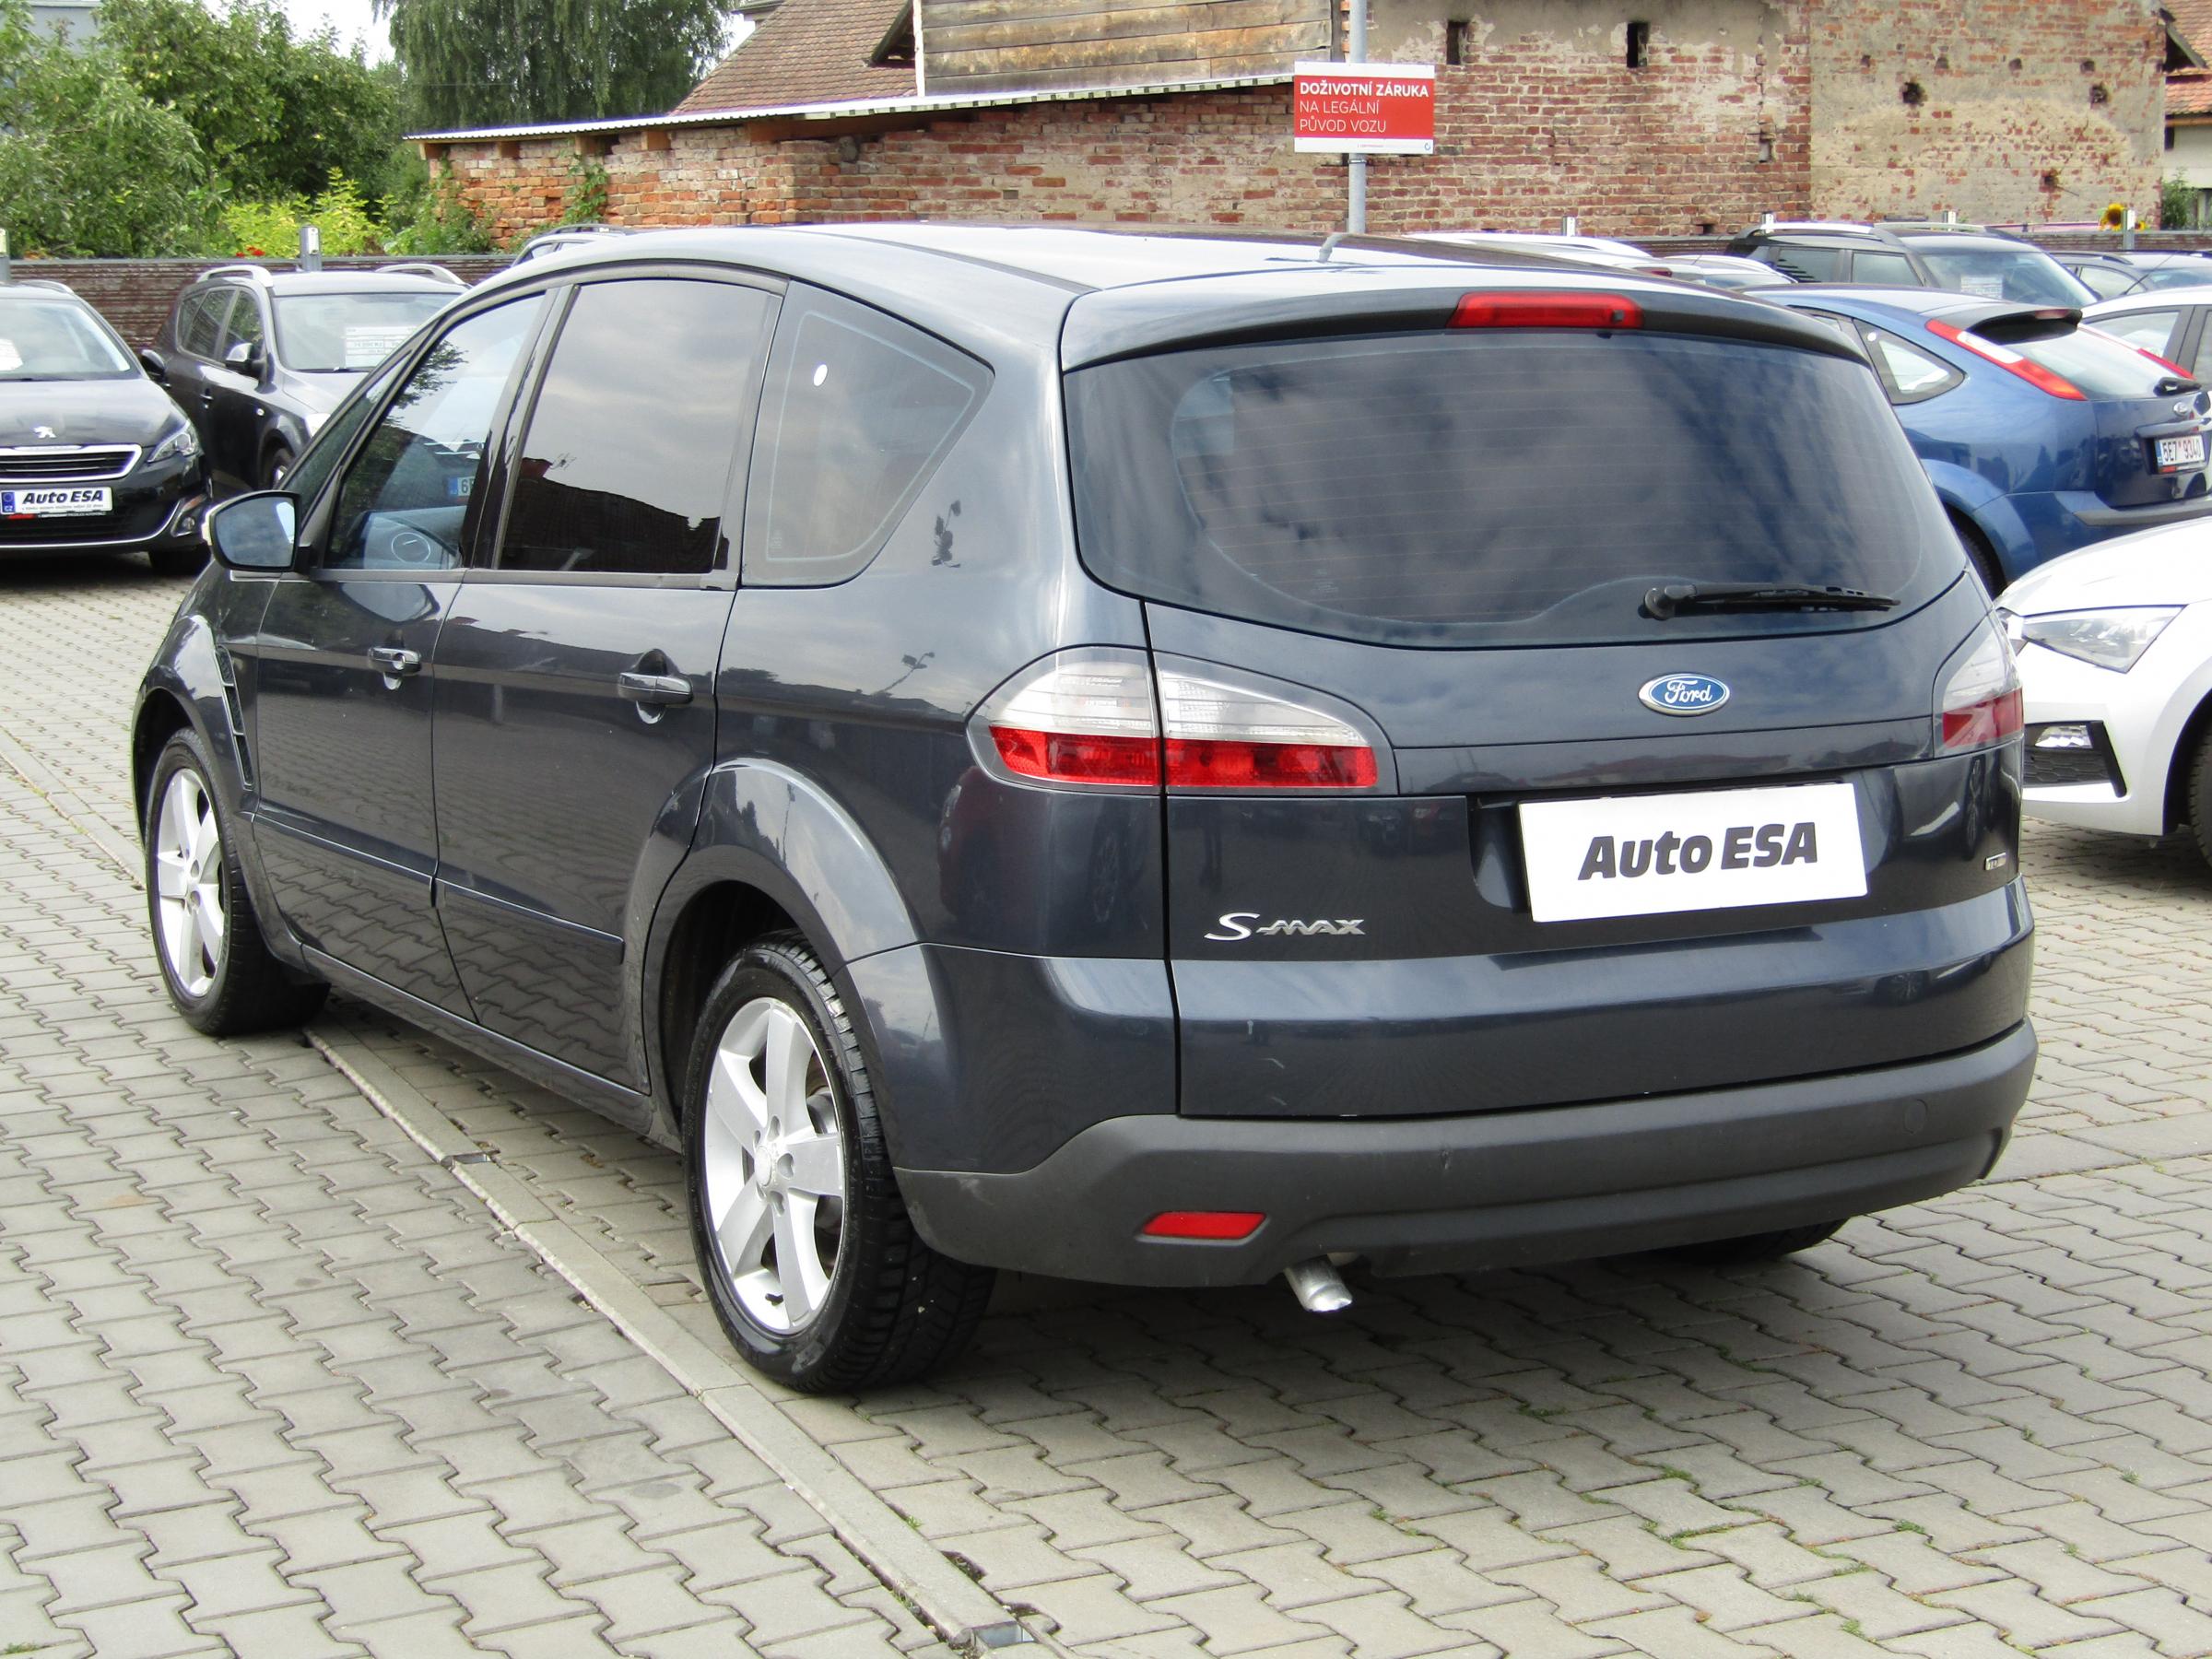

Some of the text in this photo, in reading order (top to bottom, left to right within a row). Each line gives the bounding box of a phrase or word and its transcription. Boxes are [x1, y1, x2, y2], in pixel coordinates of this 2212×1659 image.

[1300, 79, 1430, 97] DOŽIVOTNÍ ZÁRUKA
[1300, 99, 1380, 114] NA LEGÁLNÍ
[1300, 115, 1387, 133] PŮVOD VOZU
[22, 489, 103, 504] Auto ESA
[1664, 679, 1712, 704] Ford
[1577, 821, 1818, 881] Auto ESA
